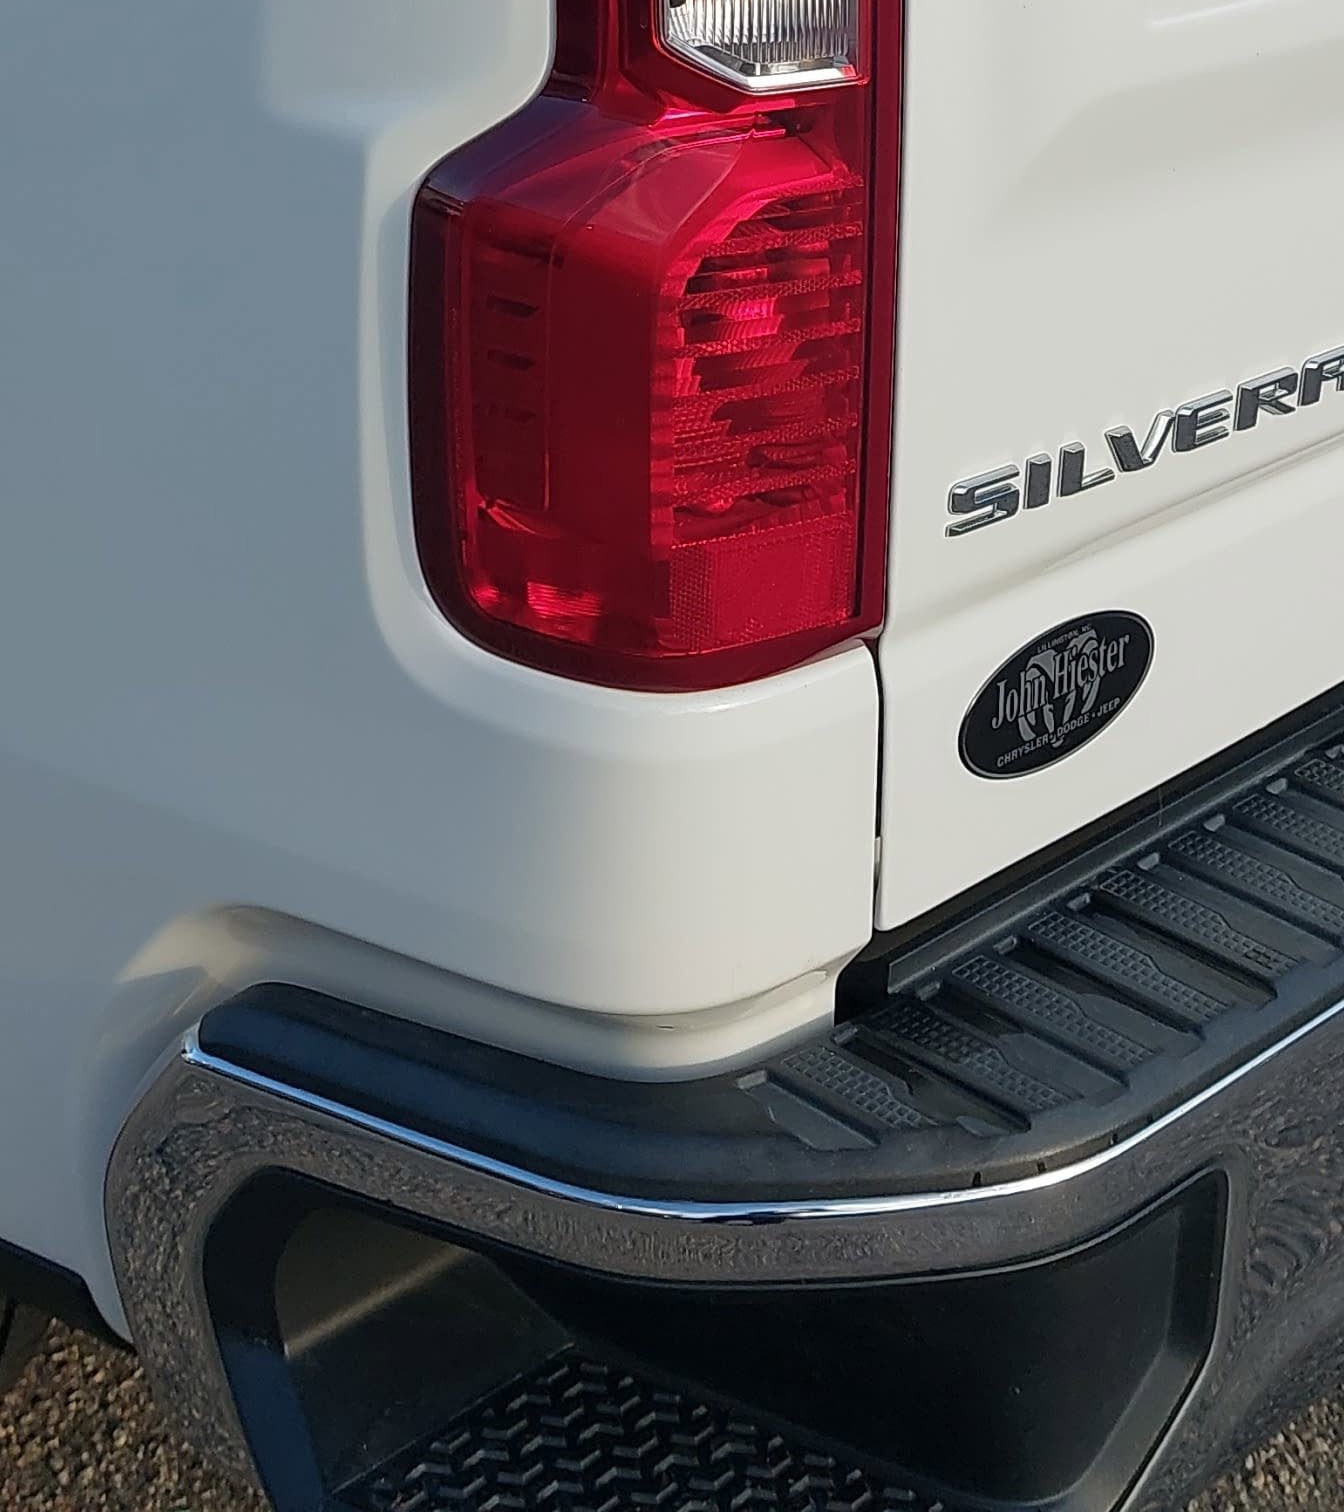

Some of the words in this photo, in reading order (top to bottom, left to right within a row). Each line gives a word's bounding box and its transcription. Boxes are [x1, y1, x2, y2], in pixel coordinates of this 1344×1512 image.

[991, 669, 1047, 729] John
[1052, 634, 1130, 699] Hiester
[996, 734, 1050, 768] CHRYSLER
[1056, 712, 1090, 737] DODGE
[1097, 697, 1122, 719] JEEP
